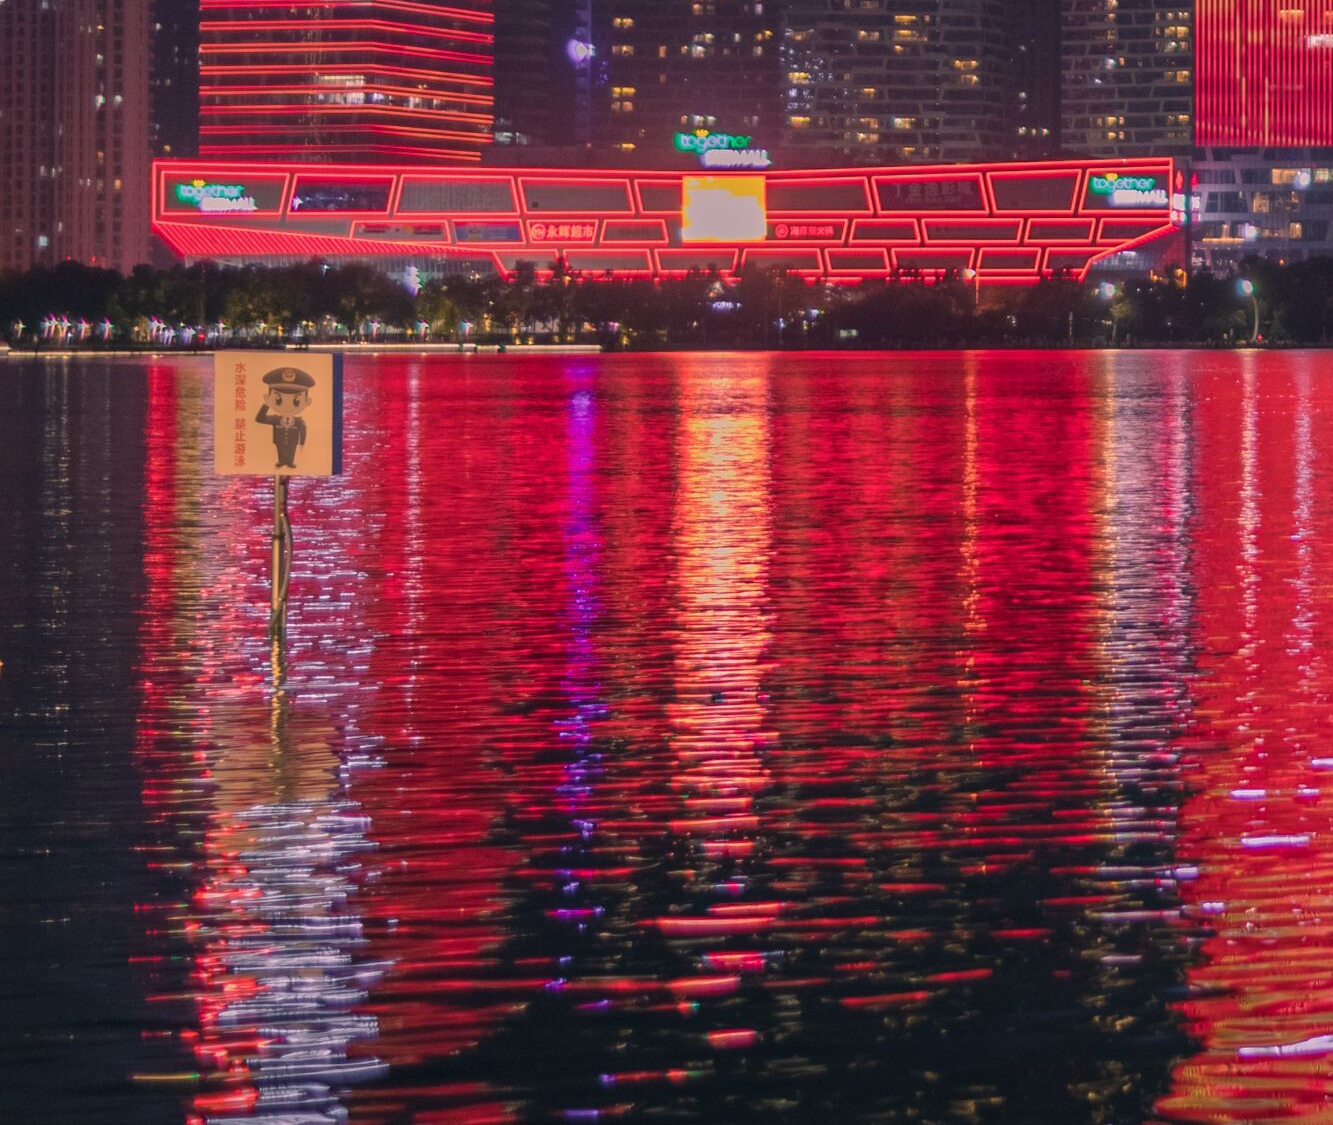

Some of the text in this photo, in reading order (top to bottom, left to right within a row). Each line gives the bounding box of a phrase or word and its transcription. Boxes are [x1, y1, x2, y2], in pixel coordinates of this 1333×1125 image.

[234, 362, 247, 467] 水深危险 禁止游泳
